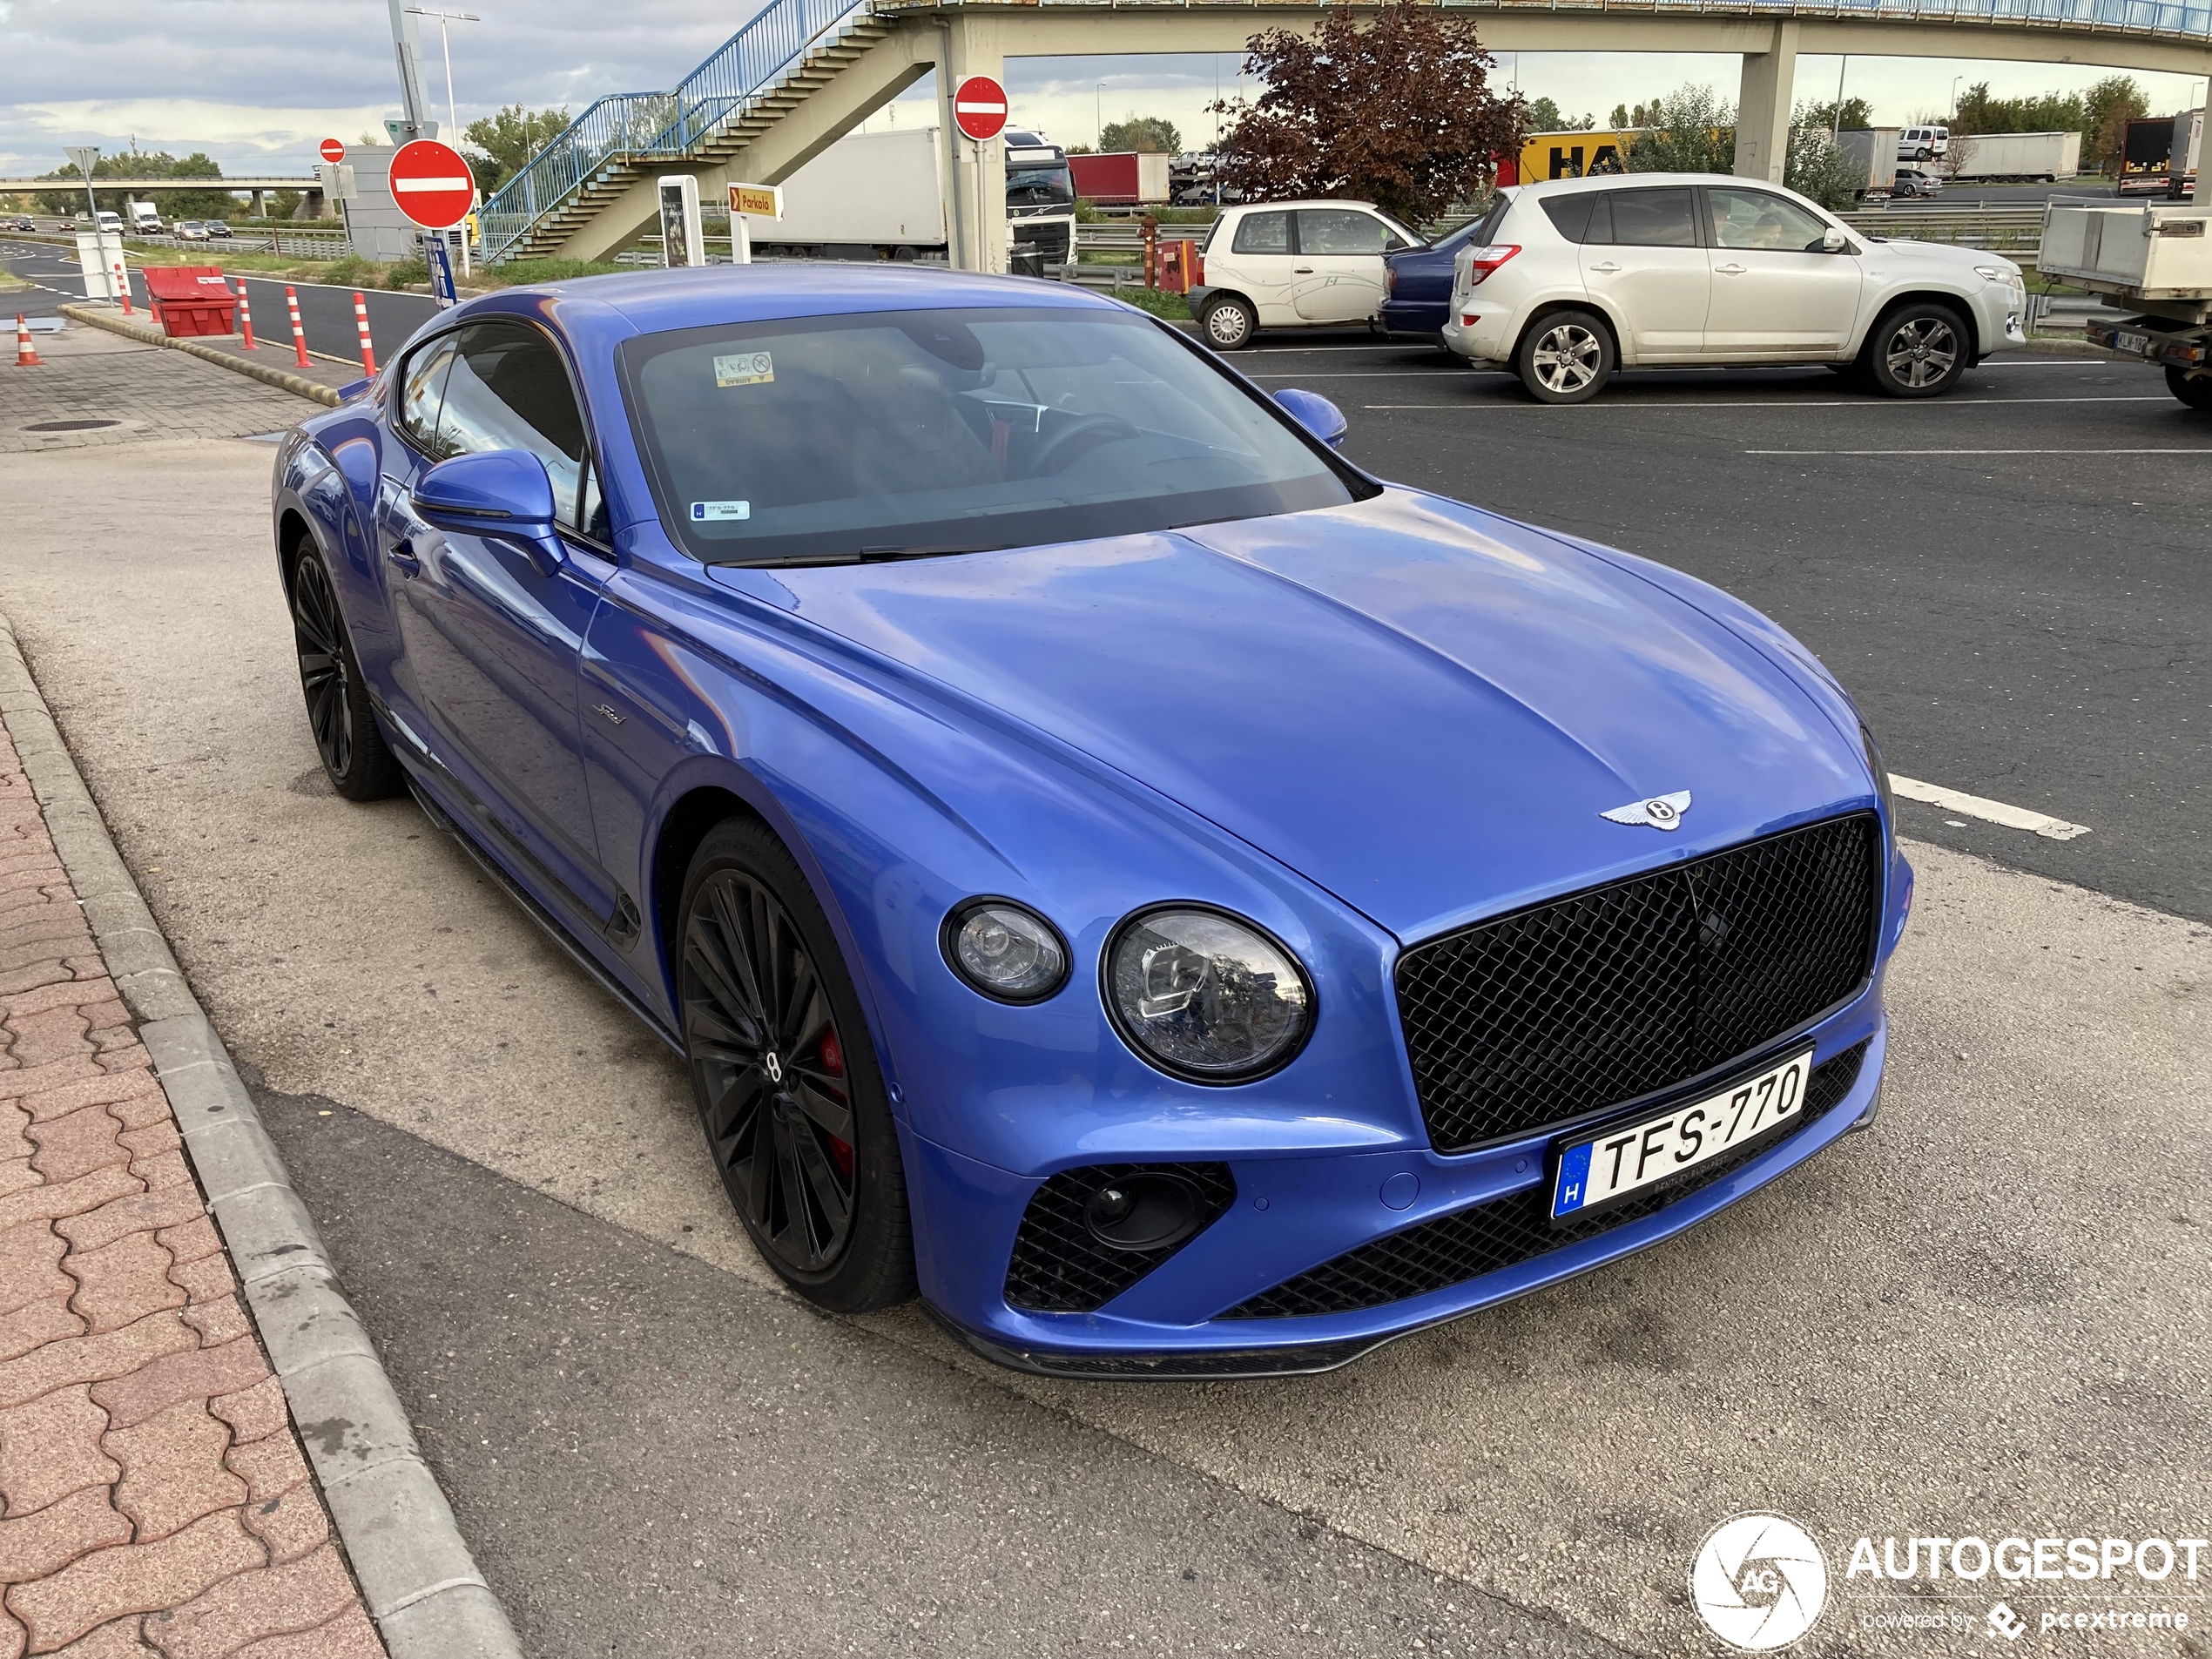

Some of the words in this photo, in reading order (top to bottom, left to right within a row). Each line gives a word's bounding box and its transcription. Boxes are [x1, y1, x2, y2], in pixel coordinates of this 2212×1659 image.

[1564, 1182, 1579, 1204] H
[1604, 1063, 1800, 1190] TFS-770
[1654, 1172, 1689, 1193] BENTLEY
